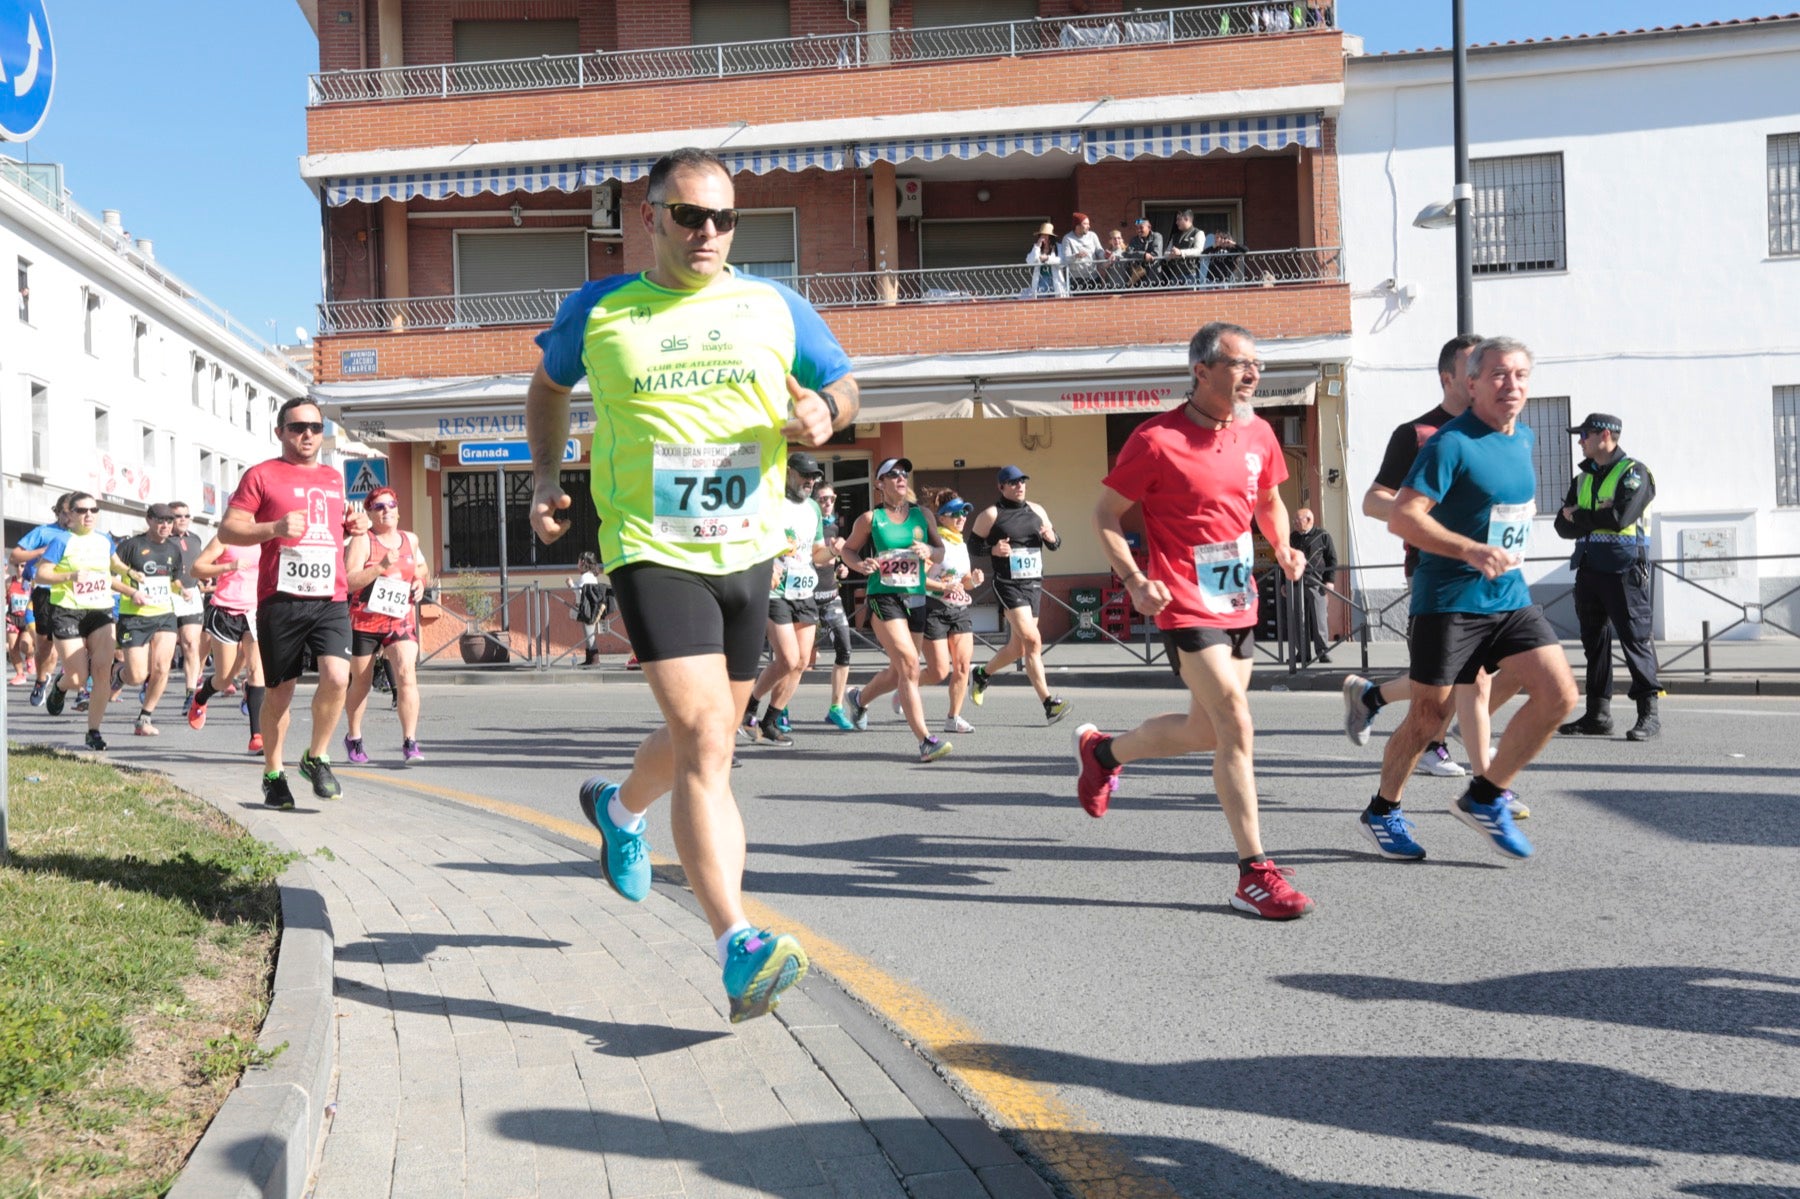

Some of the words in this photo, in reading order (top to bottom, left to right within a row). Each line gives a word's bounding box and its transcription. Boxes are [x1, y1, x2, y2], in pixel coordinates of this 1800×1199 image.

[352, 357, 374, 366] JACOBO
[646, 364, 672, 373] CLUB
[675, 361, 686, 369] DE
[344, 364, 376, 374] CAMARERO
[634, 368, 757, 394] MARACENA
[462, 447, 509, 459] Granada
[682, 446, 702, 457] GRAN
[674, 475, 747, 511] 750
[1502, 524, 1531, 549] 64
[286, 561, 332, 579] 3089
[881, 561, 917, 575] 2292
[1016, 557, 1037, 569] 197
[76, 579, 107, 595] 2242
[792, 575, 814, 589] 265
[376, 587, 407, 606] 3152
